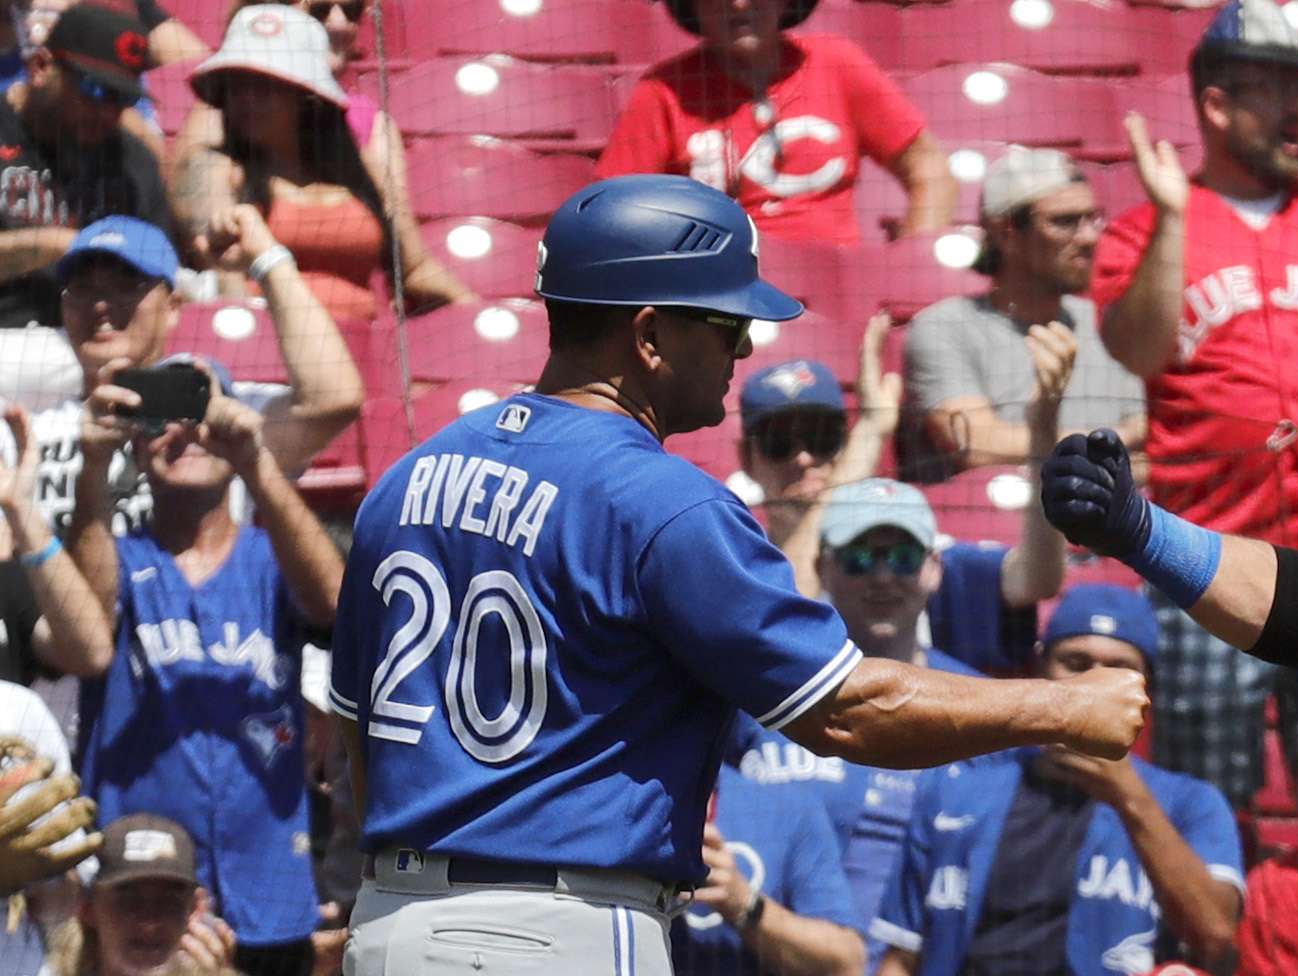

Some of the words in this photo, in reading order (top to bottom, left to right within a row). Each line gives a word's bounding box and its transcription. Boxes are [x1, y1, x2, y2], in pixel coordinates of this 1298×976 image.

[742, 115, 847, 198] C
[399, 453, 559, 557] RIVERA
[367, 550, 548, 763] 20
